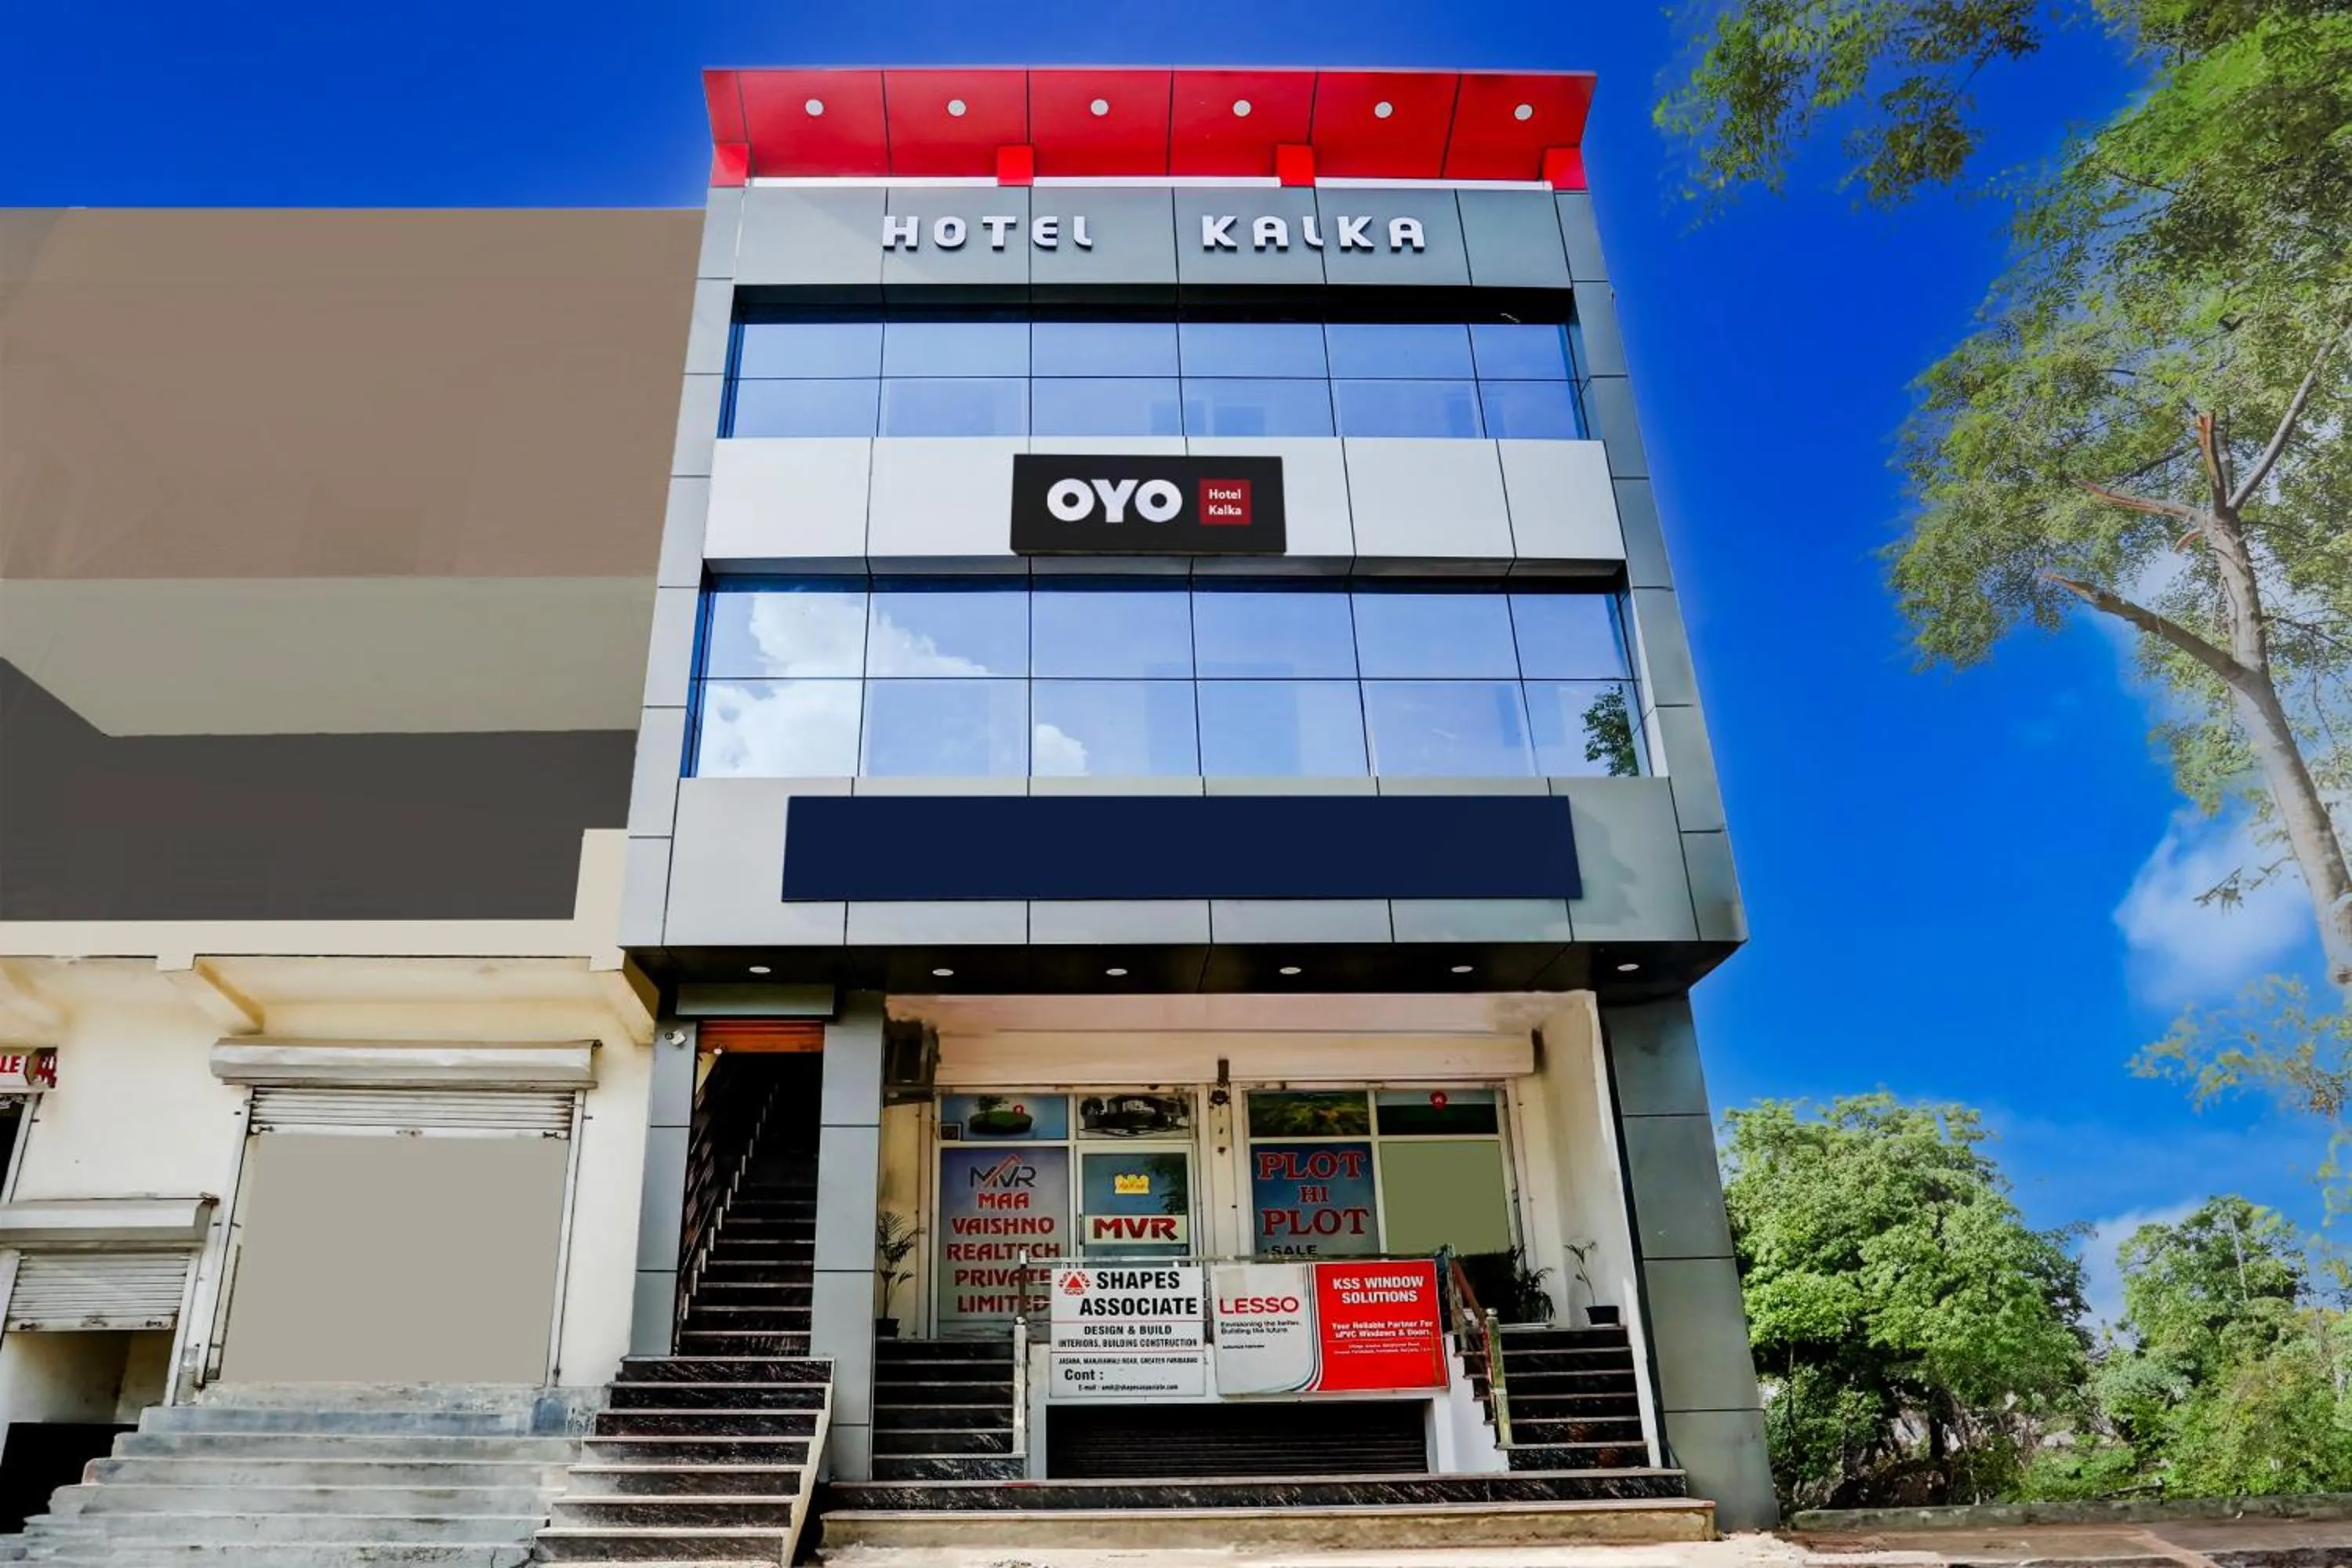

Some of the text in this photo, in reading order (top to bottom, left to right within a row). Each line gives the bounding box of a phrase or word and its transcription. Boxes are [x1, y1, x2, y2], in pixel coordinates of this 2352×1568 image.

[882, 215, 1426, 252] HOTEL KALKA
[1047, 477, 1182, 523] OYO
[1209, 488, 1242, 500] Hotel
[1209, 504, 1243, 516] Kalka
[1257, 1152, 1366, 1179] PLOT
[978, 1192, 1029, 1210] MAA
[1298, 1185, 1329, 1203] HI
[951, 1216, 1055, 1236] VAISHNO
[1092, 1217, 1178, 1240] MVR
[1261, 1207, 1369, 1236] PLOT
[946, 1243, 1060, 1261] REALTECH
[1271, 1244, 1318, 1255] SALE
[954, 1269, 1051, 1287] PRIVATE
[1096, 1271, 1180, 1290] SHAPES
[1333, 1276, 1425, 1290] KSS WINDOW
[957, 1294, 1050, 1313] LIMITED
[1220, 1296, 1299, 1314] LESSO
[1342, 1290, 1417, 1304] SOLUTIONS
[1079, 1298, 1197, 1316] ASSOCIATE
[1084, 1325, 1172, 1335] DESIGN & BUILD
[1102, 1338, 1138, 1348] BUILDING
[1139, 1338, 1197, 1348] CONSTRUCTION
[1065, 1368, 1095, 1381] Cont
